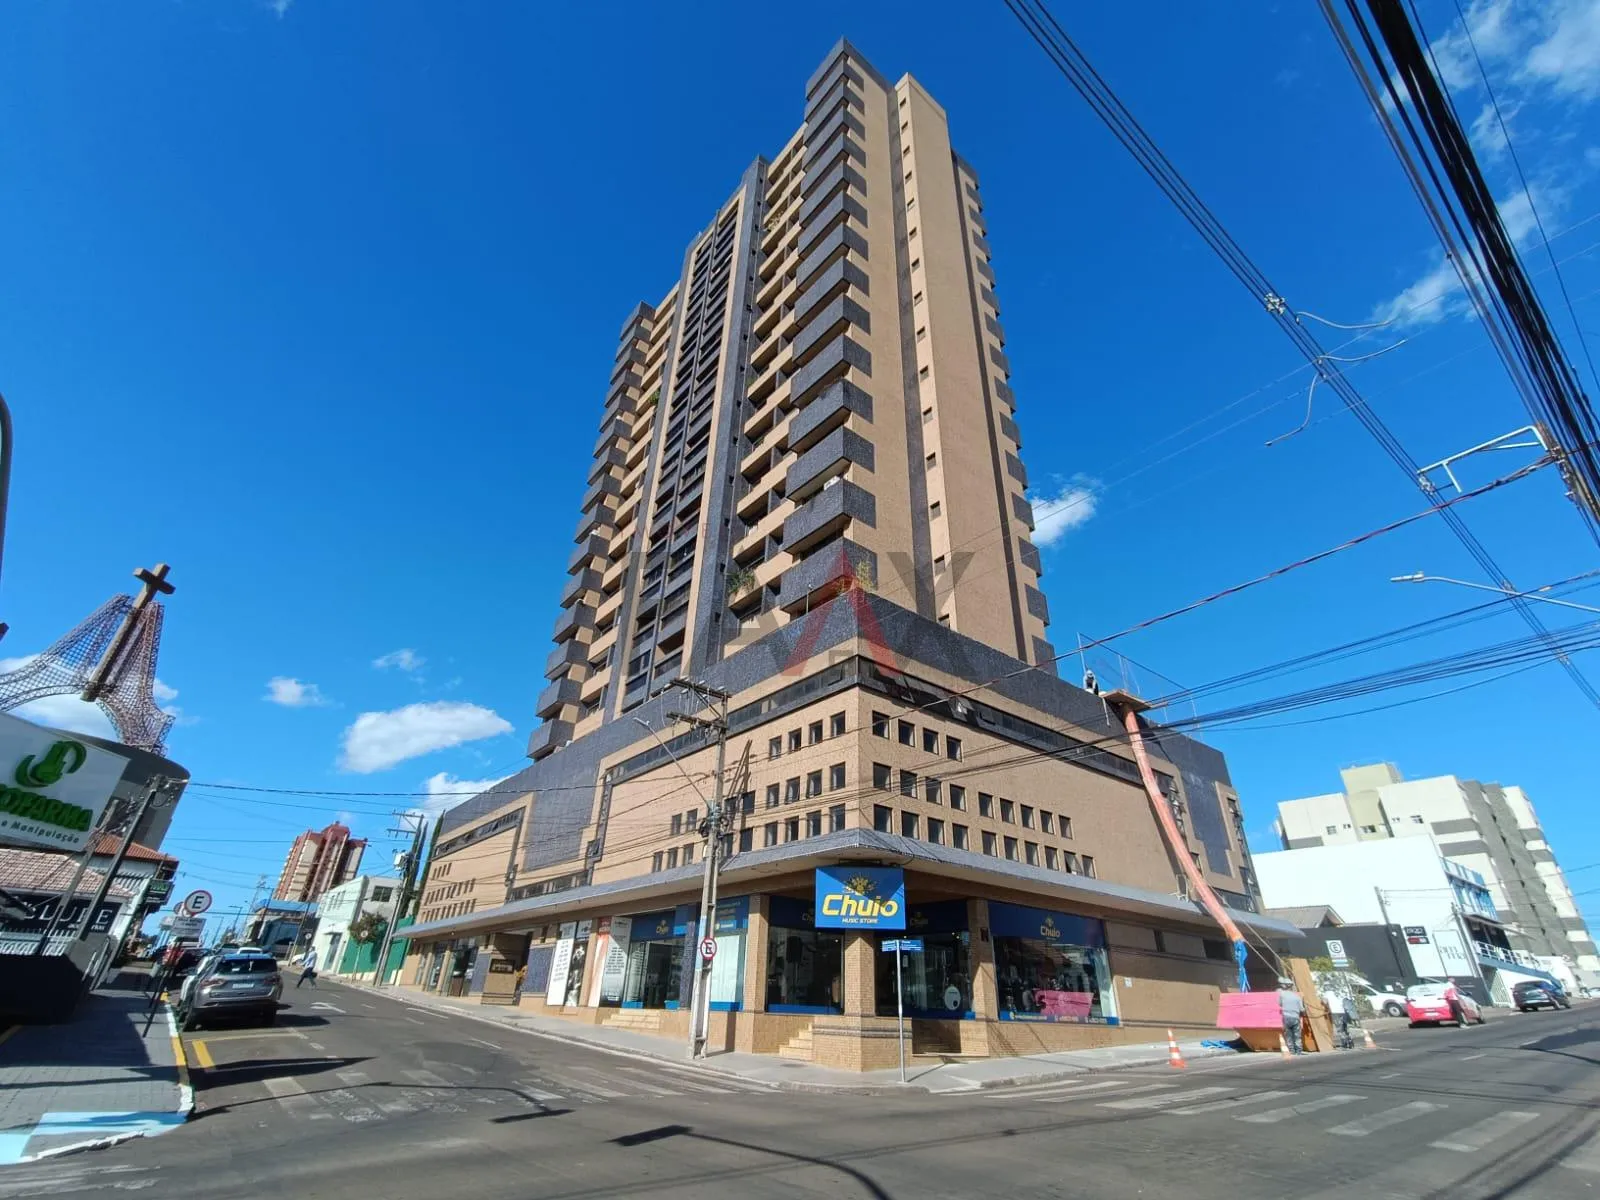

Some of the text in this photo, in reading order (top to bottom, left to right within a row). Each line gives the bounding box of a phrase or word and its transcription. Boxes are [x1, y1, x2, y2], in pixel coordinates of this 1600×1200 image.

[191, 895, 205, 909] E
[822, 894, 899, 917] Chuio
[1040, 925, 1061, 938] Chuio
